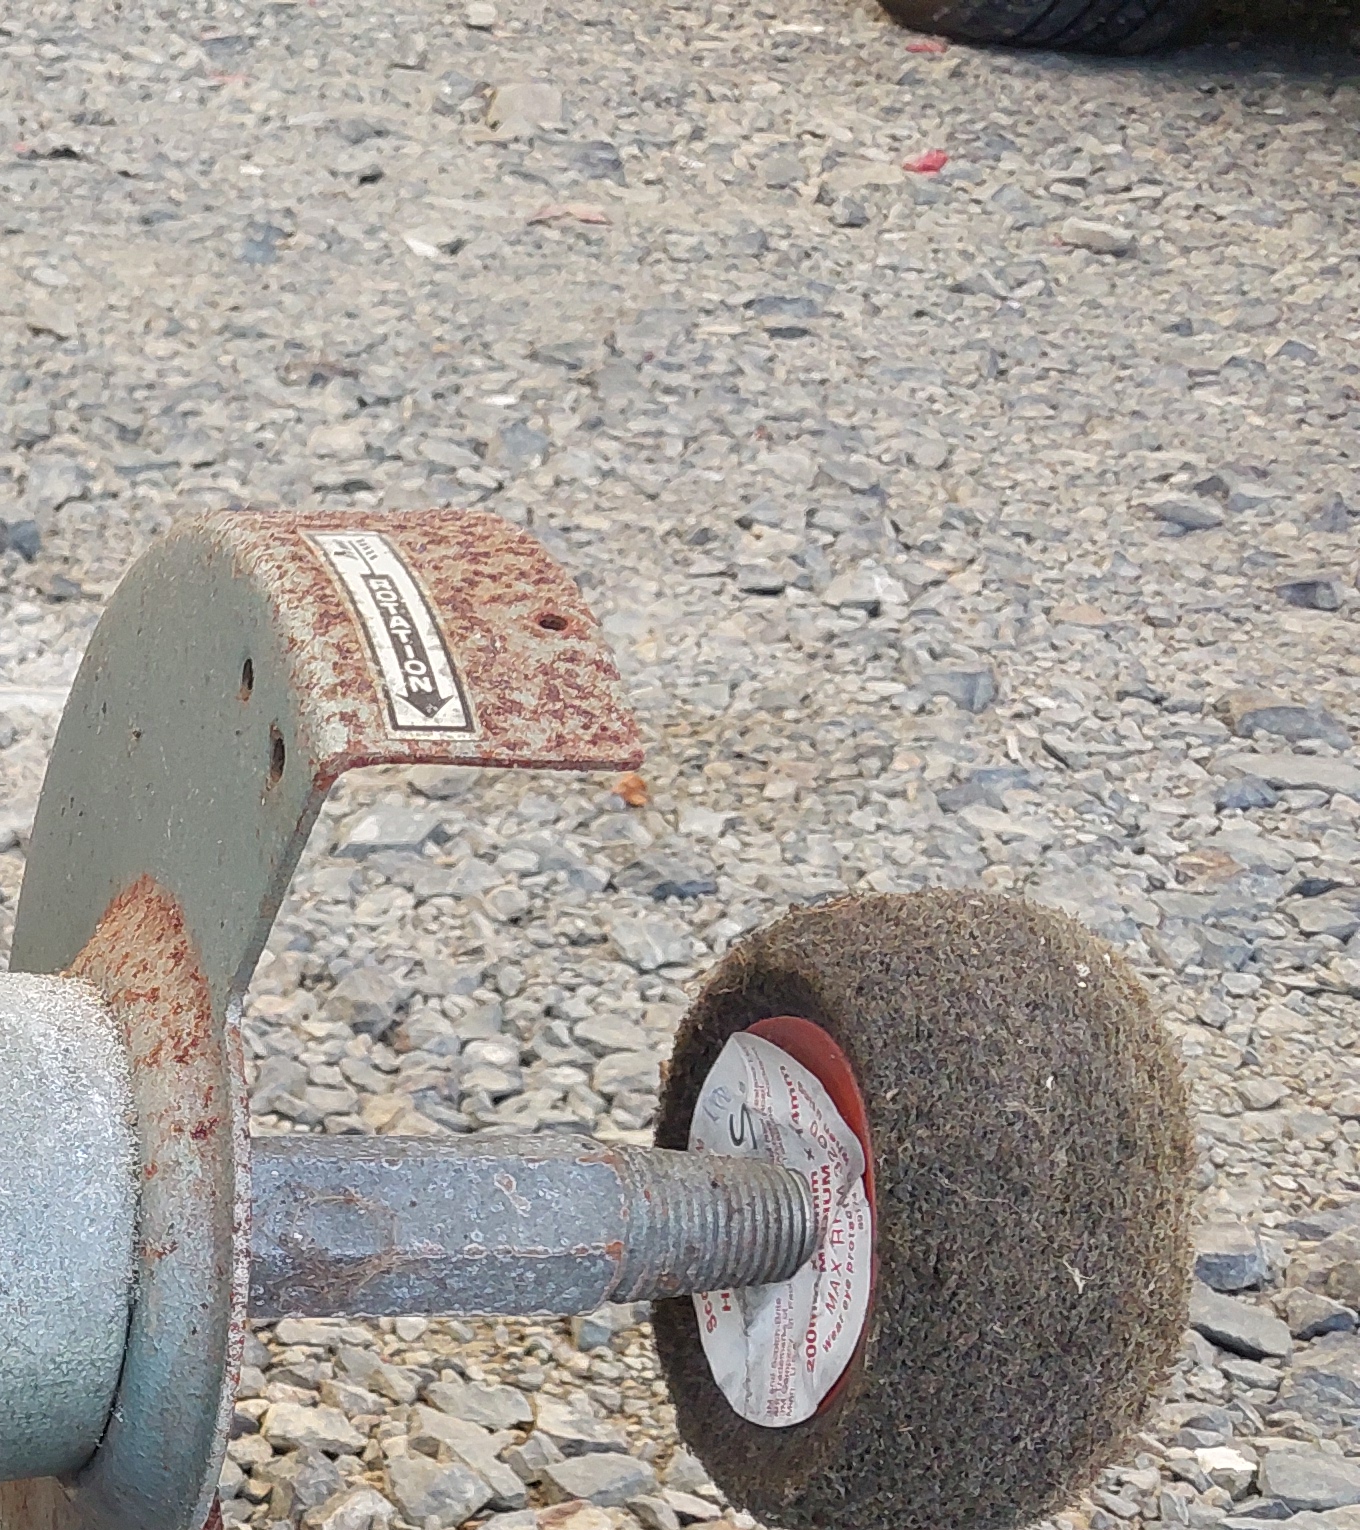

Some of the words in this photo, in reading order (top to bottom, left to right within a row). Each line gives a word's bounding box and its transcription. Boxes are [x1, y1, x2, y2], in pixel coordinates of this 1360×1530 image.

[367, 578, 433, 693] ROTATION
[825, 1259, 842, 1315] MAX
[841, 1279, 852, 1311] eye
